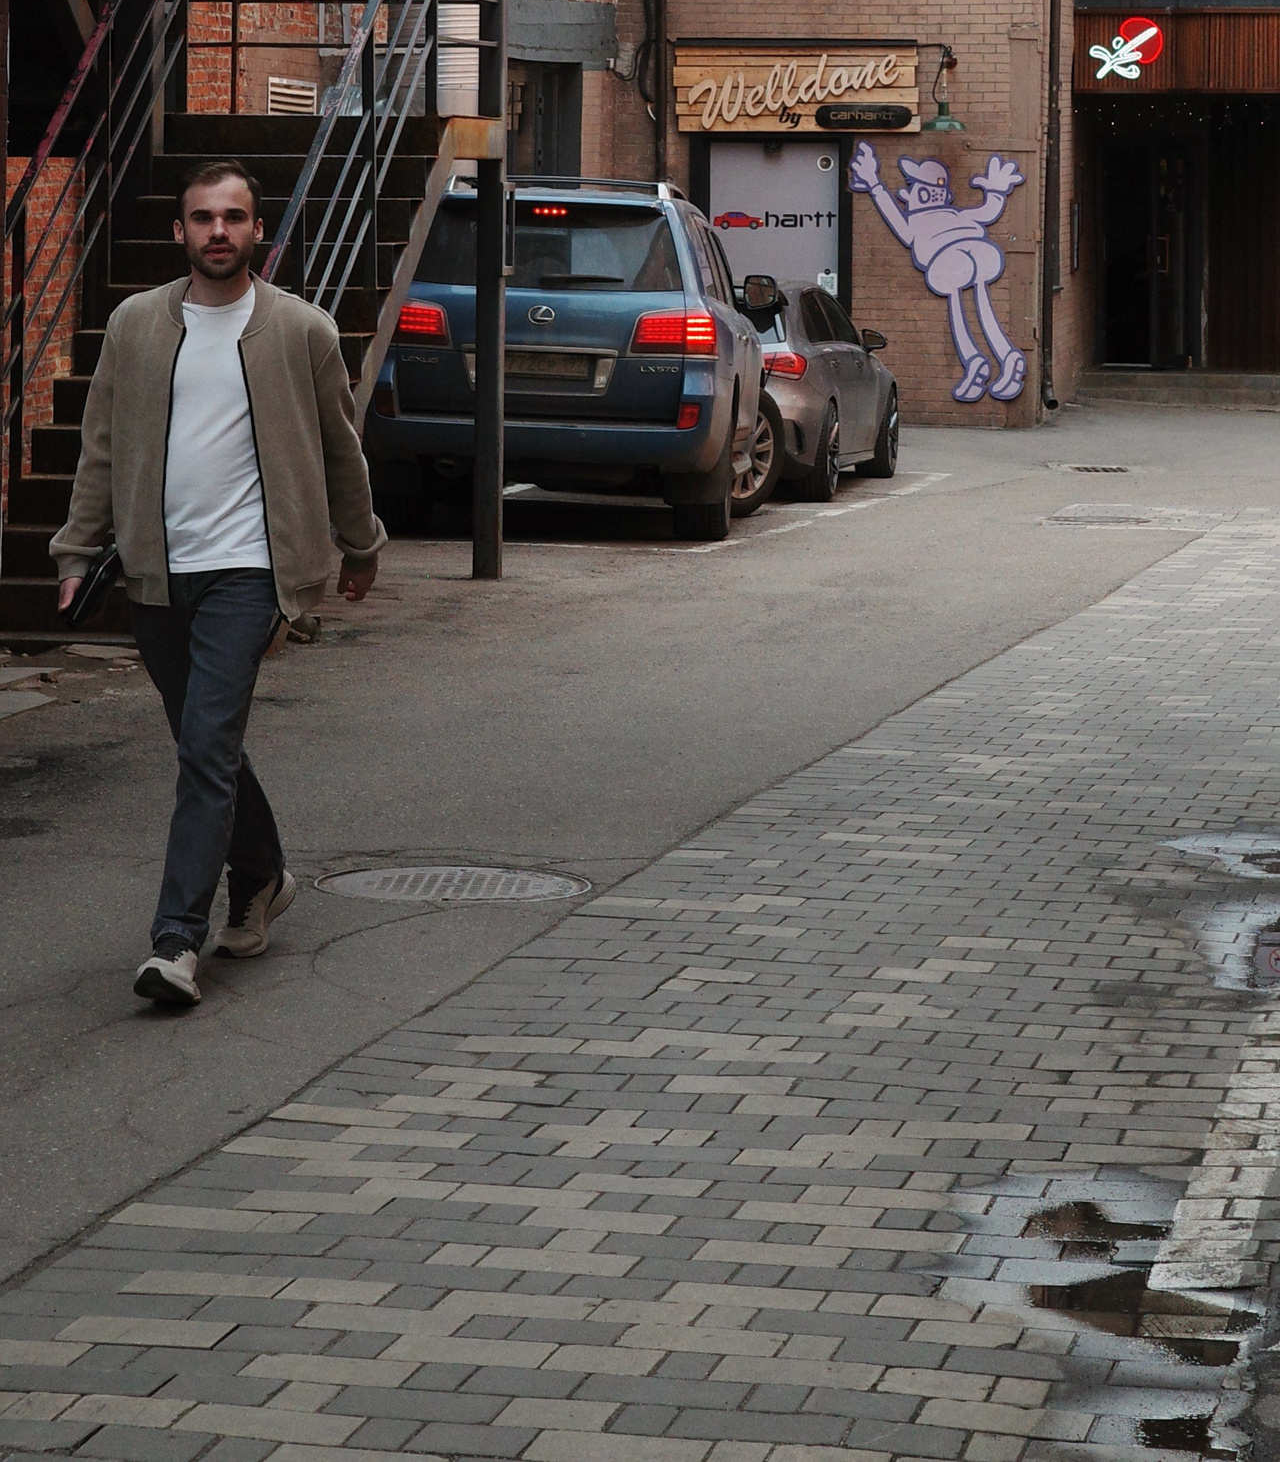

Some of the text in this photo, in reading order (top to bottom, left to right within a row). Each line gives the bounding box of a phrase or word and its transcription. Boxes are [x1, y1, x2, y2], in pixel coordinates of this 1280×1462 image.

[688, 53, 900, 129] Welldone
[778, 107, 802, 129] by
[829, 109, 895, 121] carhartt
[401, 355, 439, 363] LEXUS
